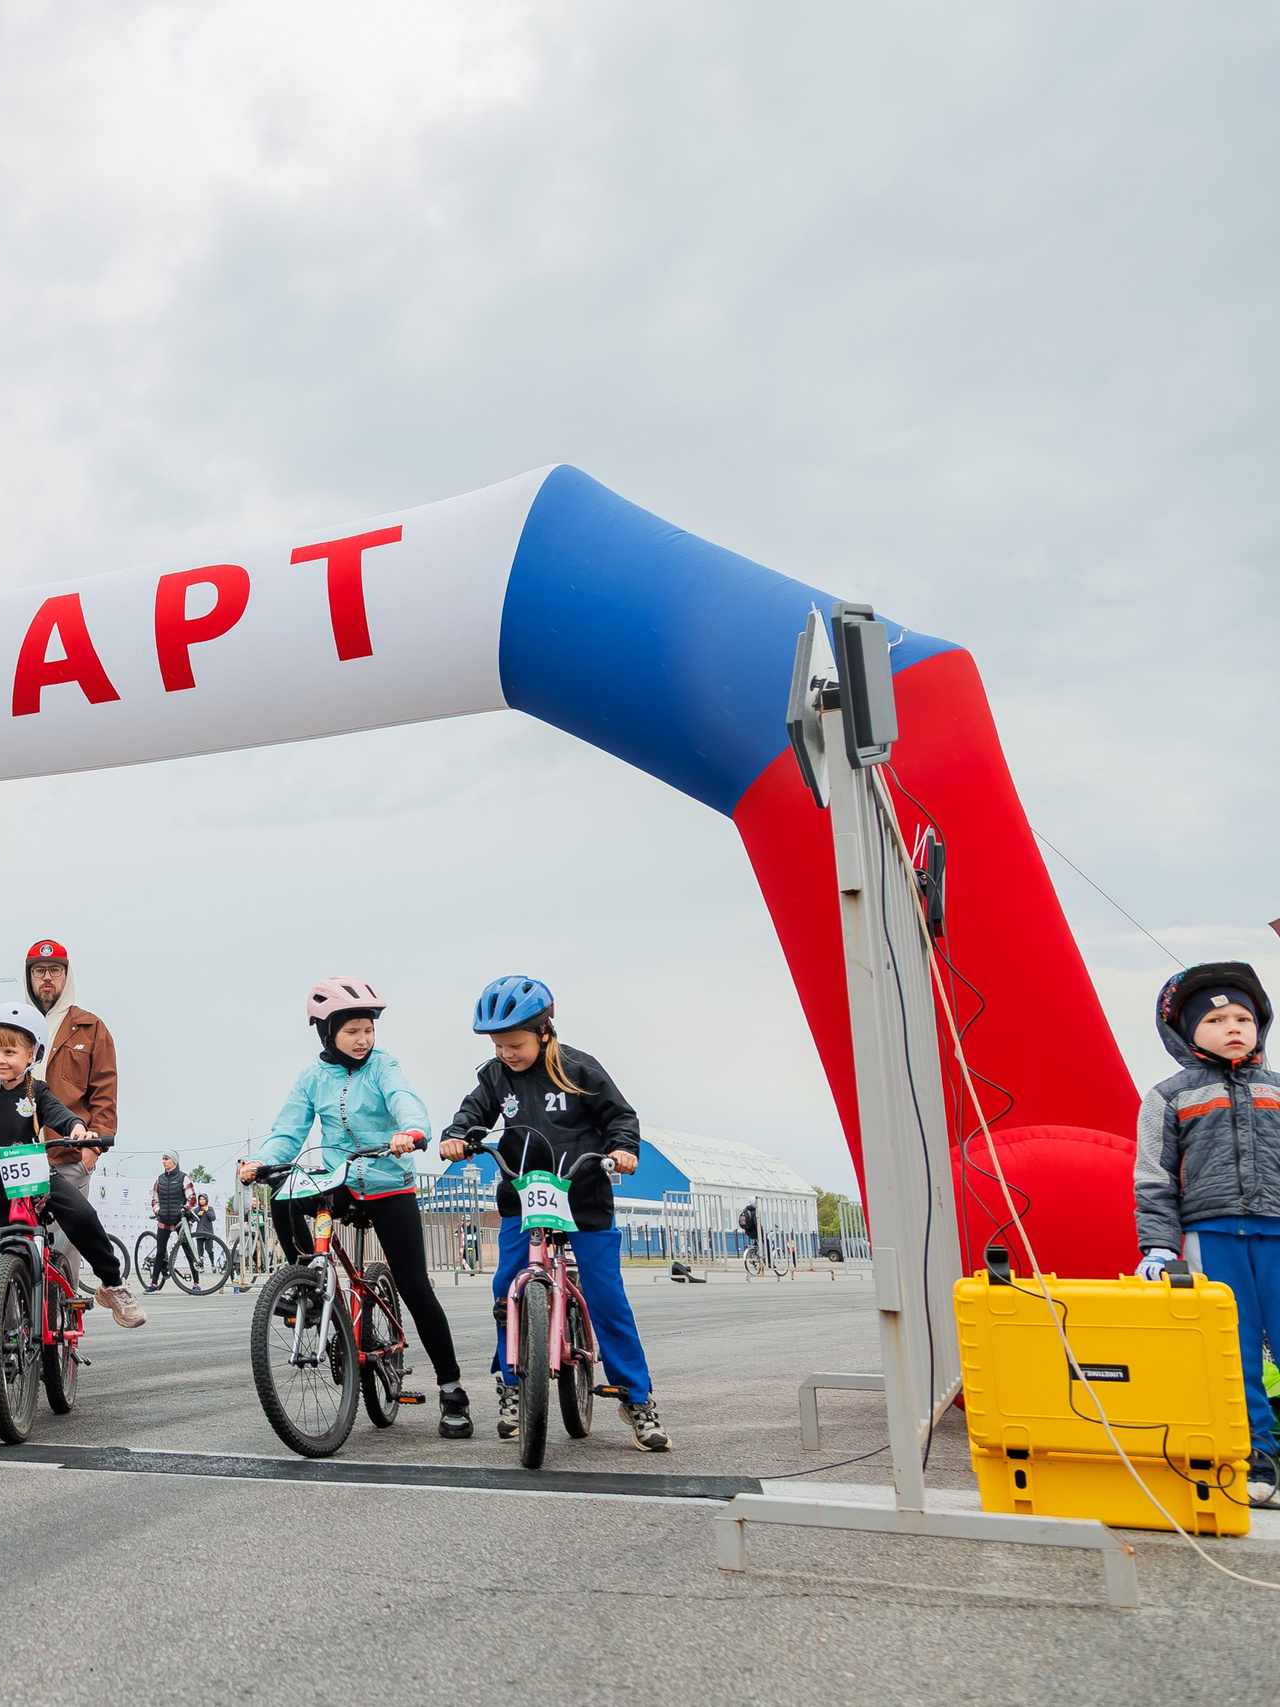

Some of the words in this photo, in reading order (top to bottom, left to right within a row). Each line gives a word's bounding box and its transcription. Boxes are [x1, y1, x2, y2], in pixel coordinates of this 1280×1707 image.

[544, 1092, 567, 1111] 21
[1, 1162, 31, 1181] 855
[527, 1190, 558, 1209] 854
